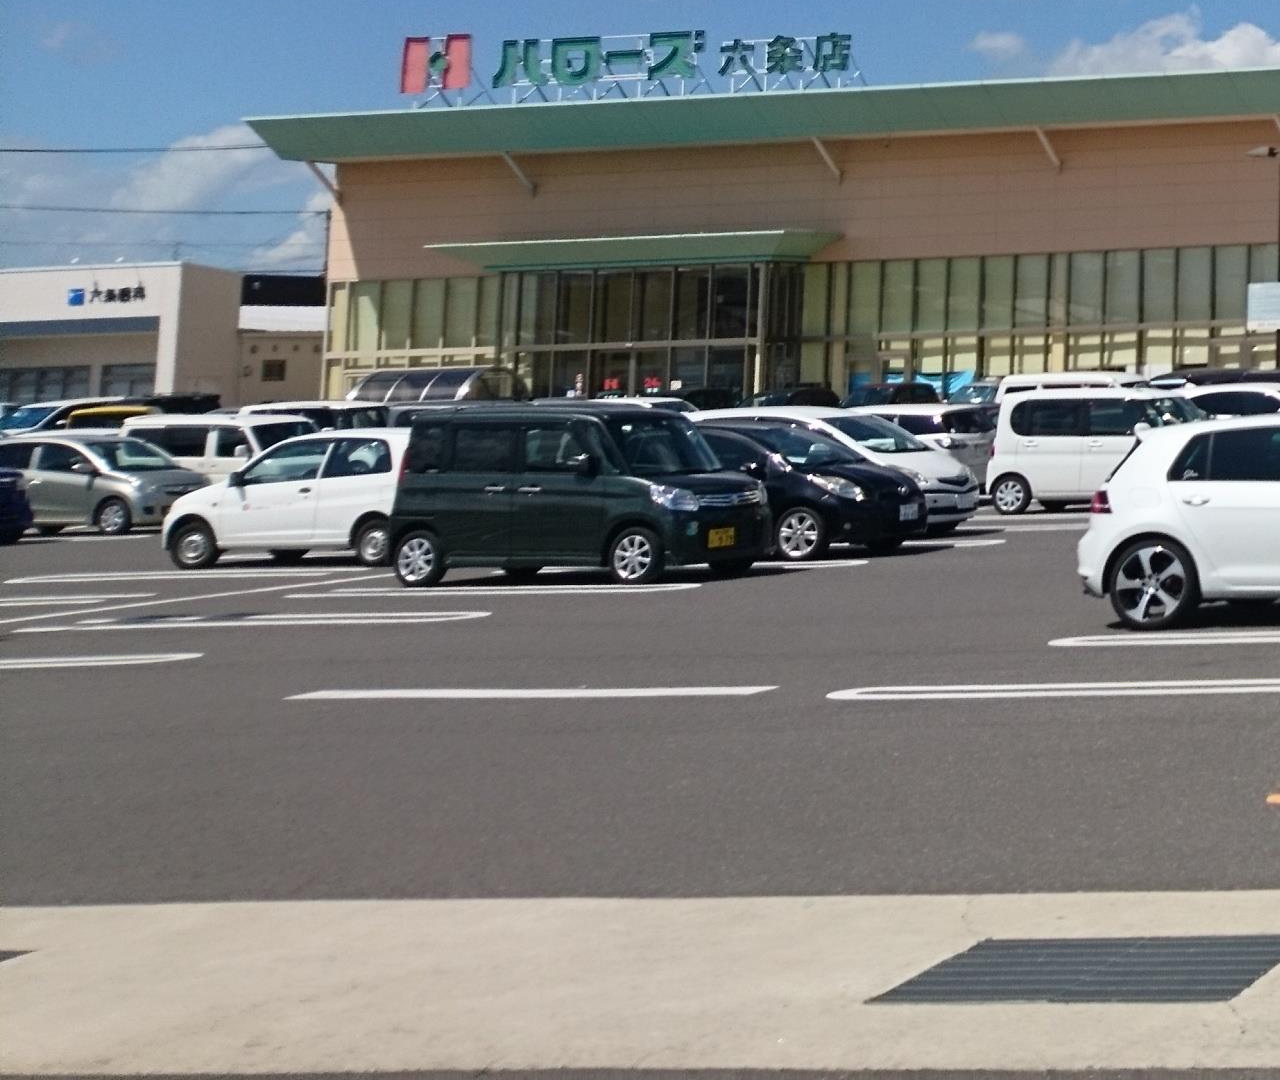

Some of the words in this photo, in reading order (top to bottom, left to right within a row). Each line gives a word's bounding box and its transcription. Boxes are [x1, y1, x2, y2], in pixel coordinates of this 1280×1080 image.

[492, 29, 705, 89] ハローズ
[718, 32, 851, 76] 六条店
